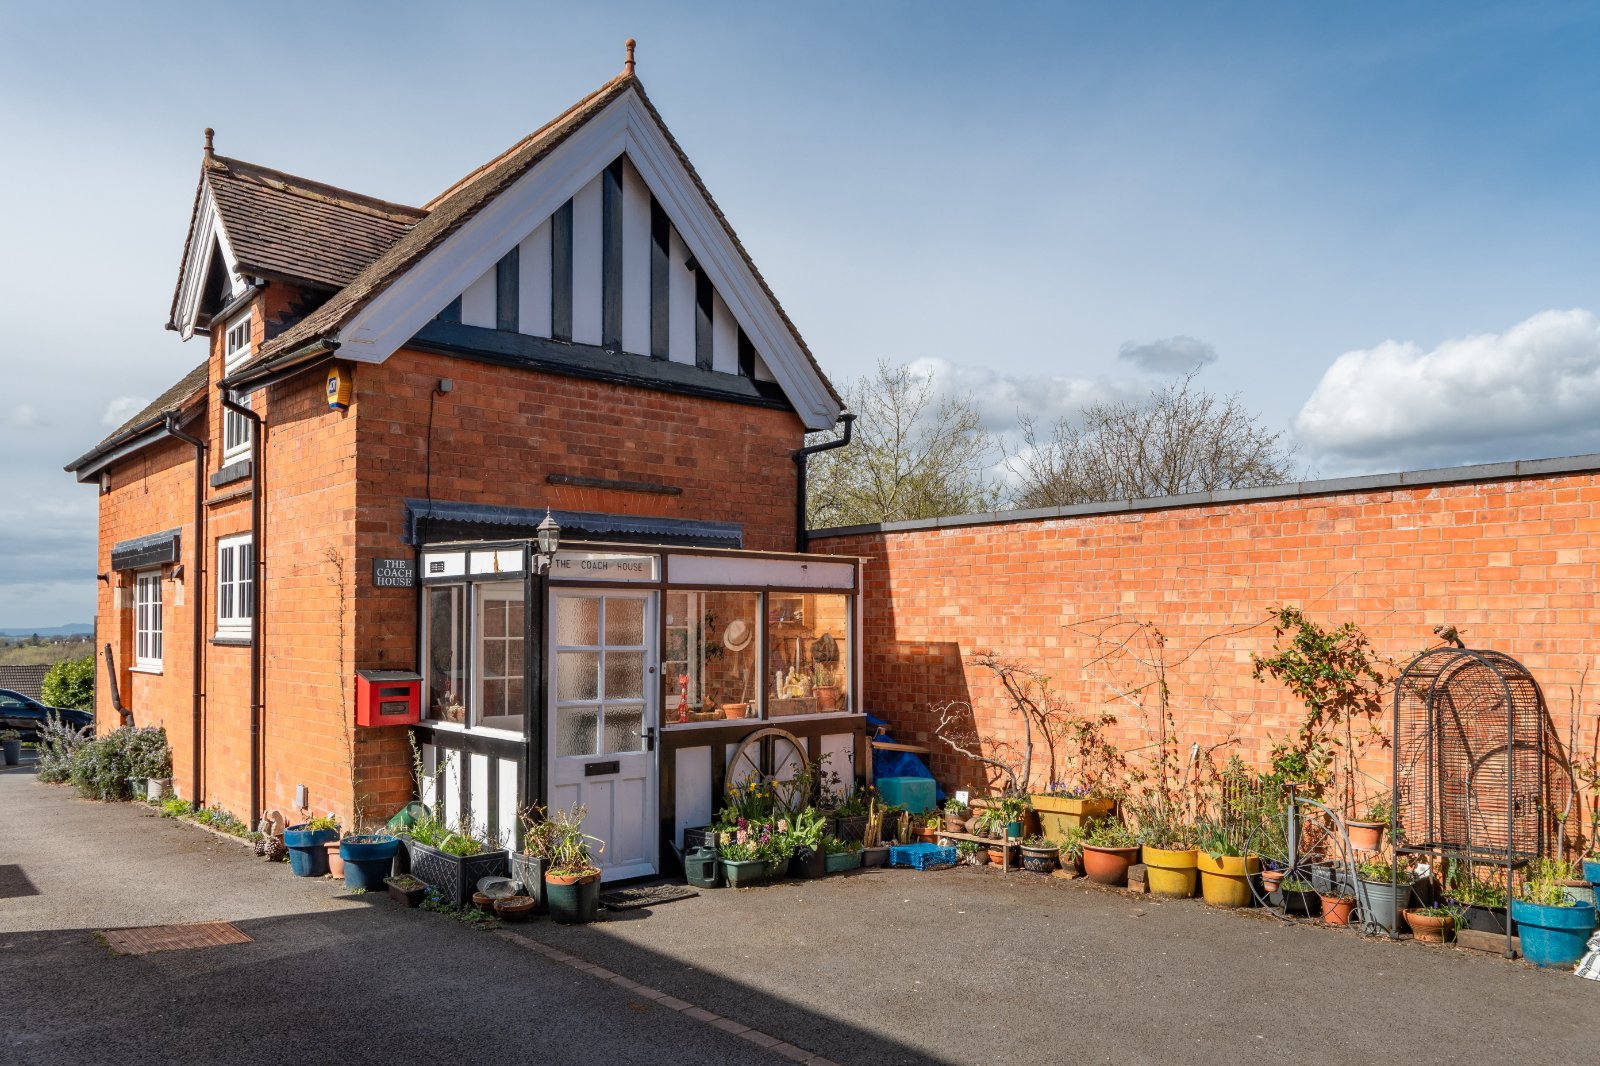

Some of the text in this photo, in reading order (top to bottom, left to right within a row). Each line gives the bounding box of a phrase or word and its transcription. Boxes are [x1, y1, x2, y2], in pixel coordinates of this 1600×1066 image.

[384, 560, 406, 569] THE
[555, 559, 643, 572] THE COACH HOUSE
[376, 568, 413, 578] COACH
[376, 577, 412, 587] HOUSE
